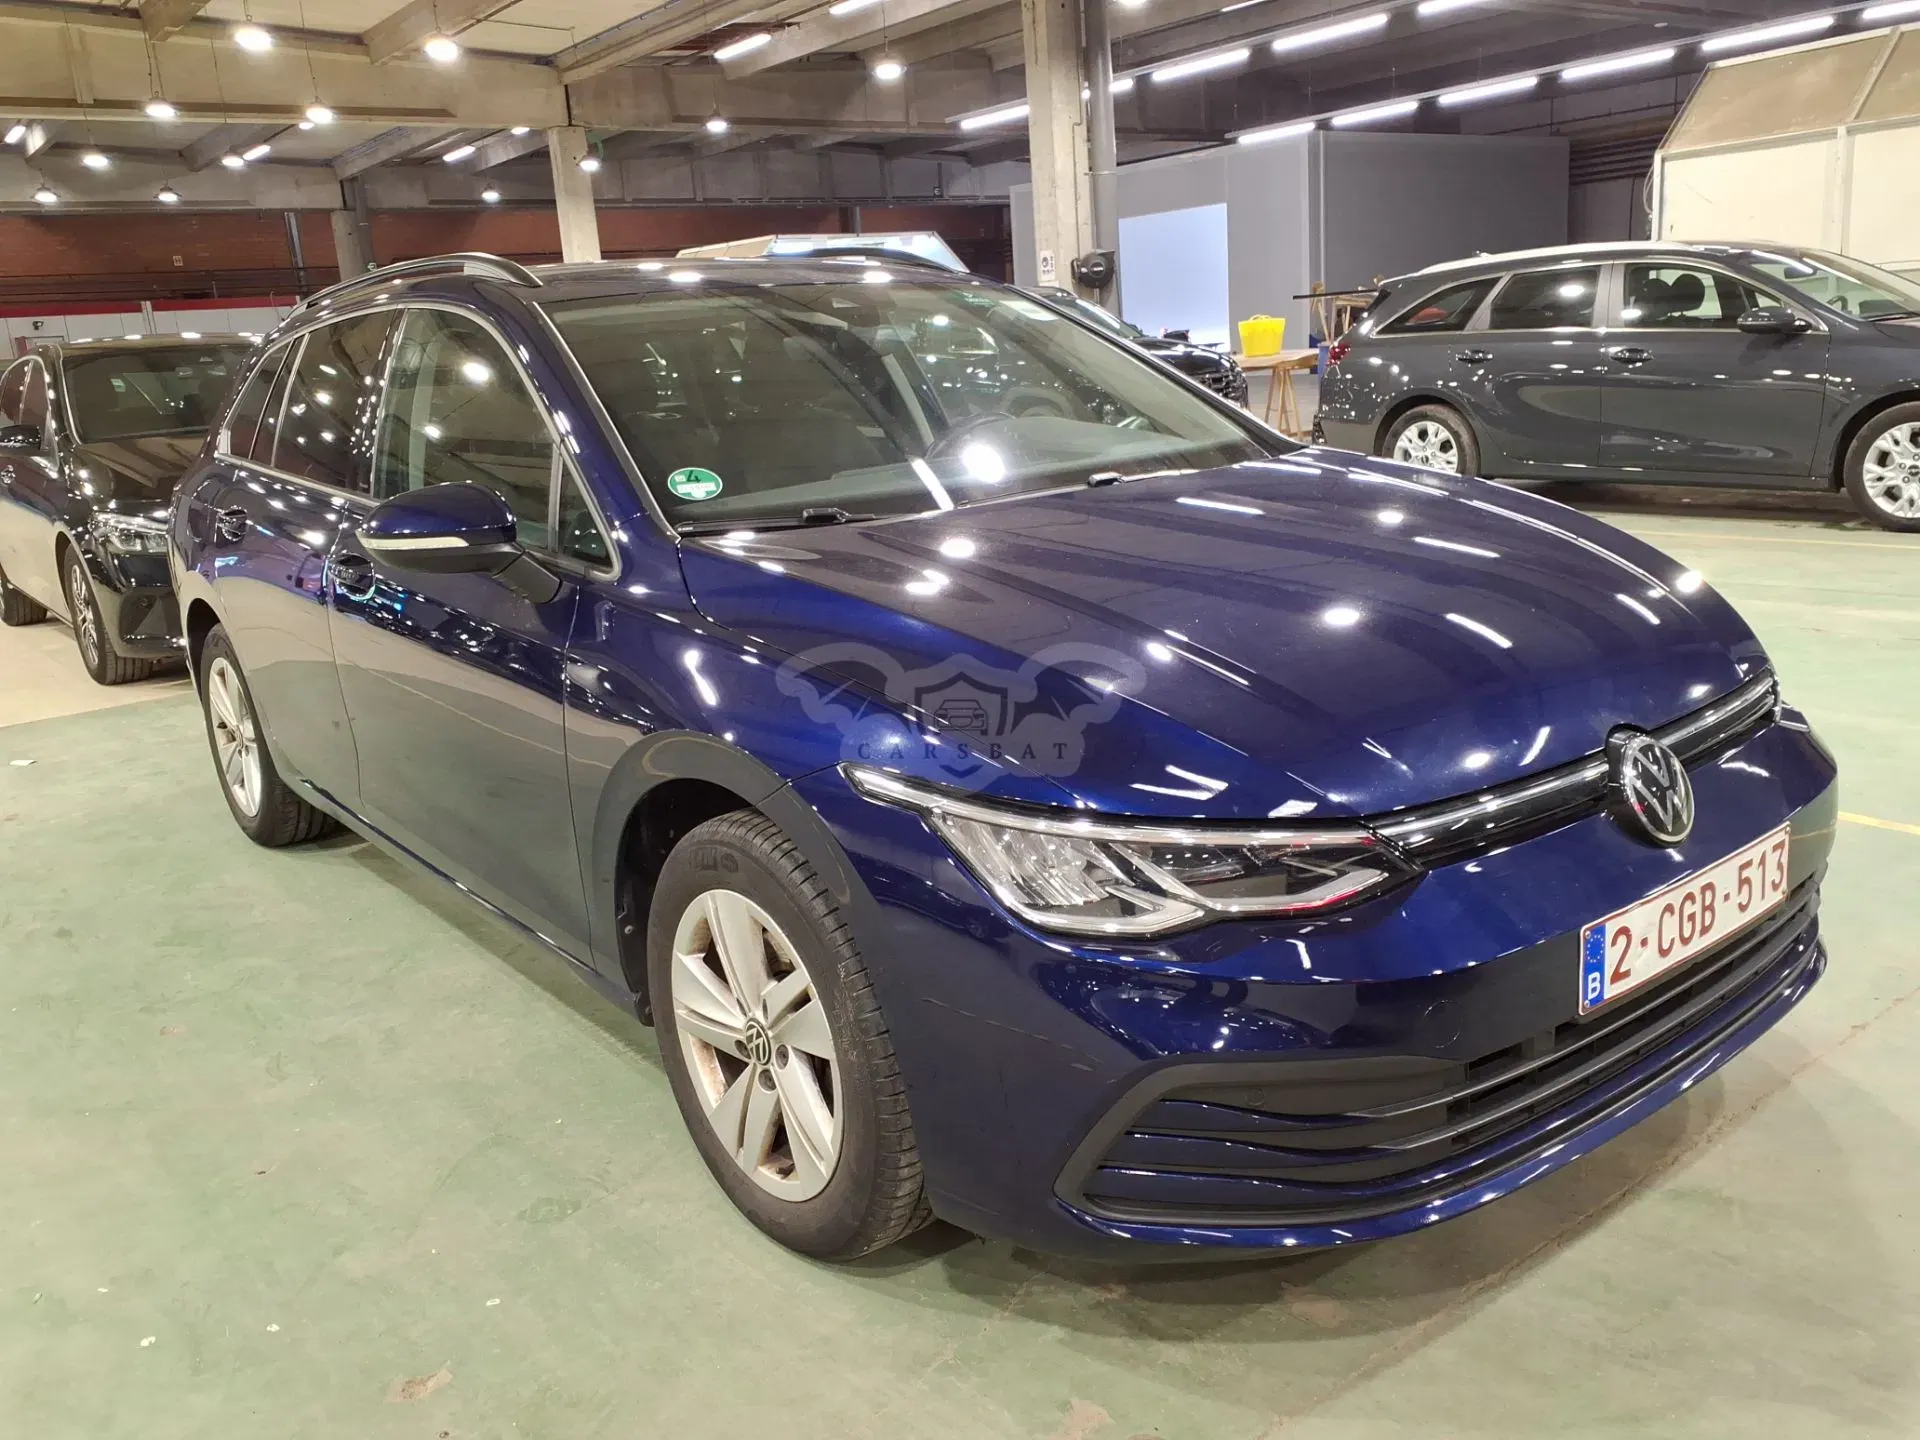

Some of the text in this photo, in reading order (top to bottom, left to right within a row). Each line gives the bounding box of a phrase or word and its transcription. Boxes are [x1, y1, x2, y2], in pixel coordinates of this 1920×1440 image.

[687, 470, 701, 482] 4
[1610, 841, 1786, 985] 2-CGB-513
[1588, 972, 1600, 1000] B
